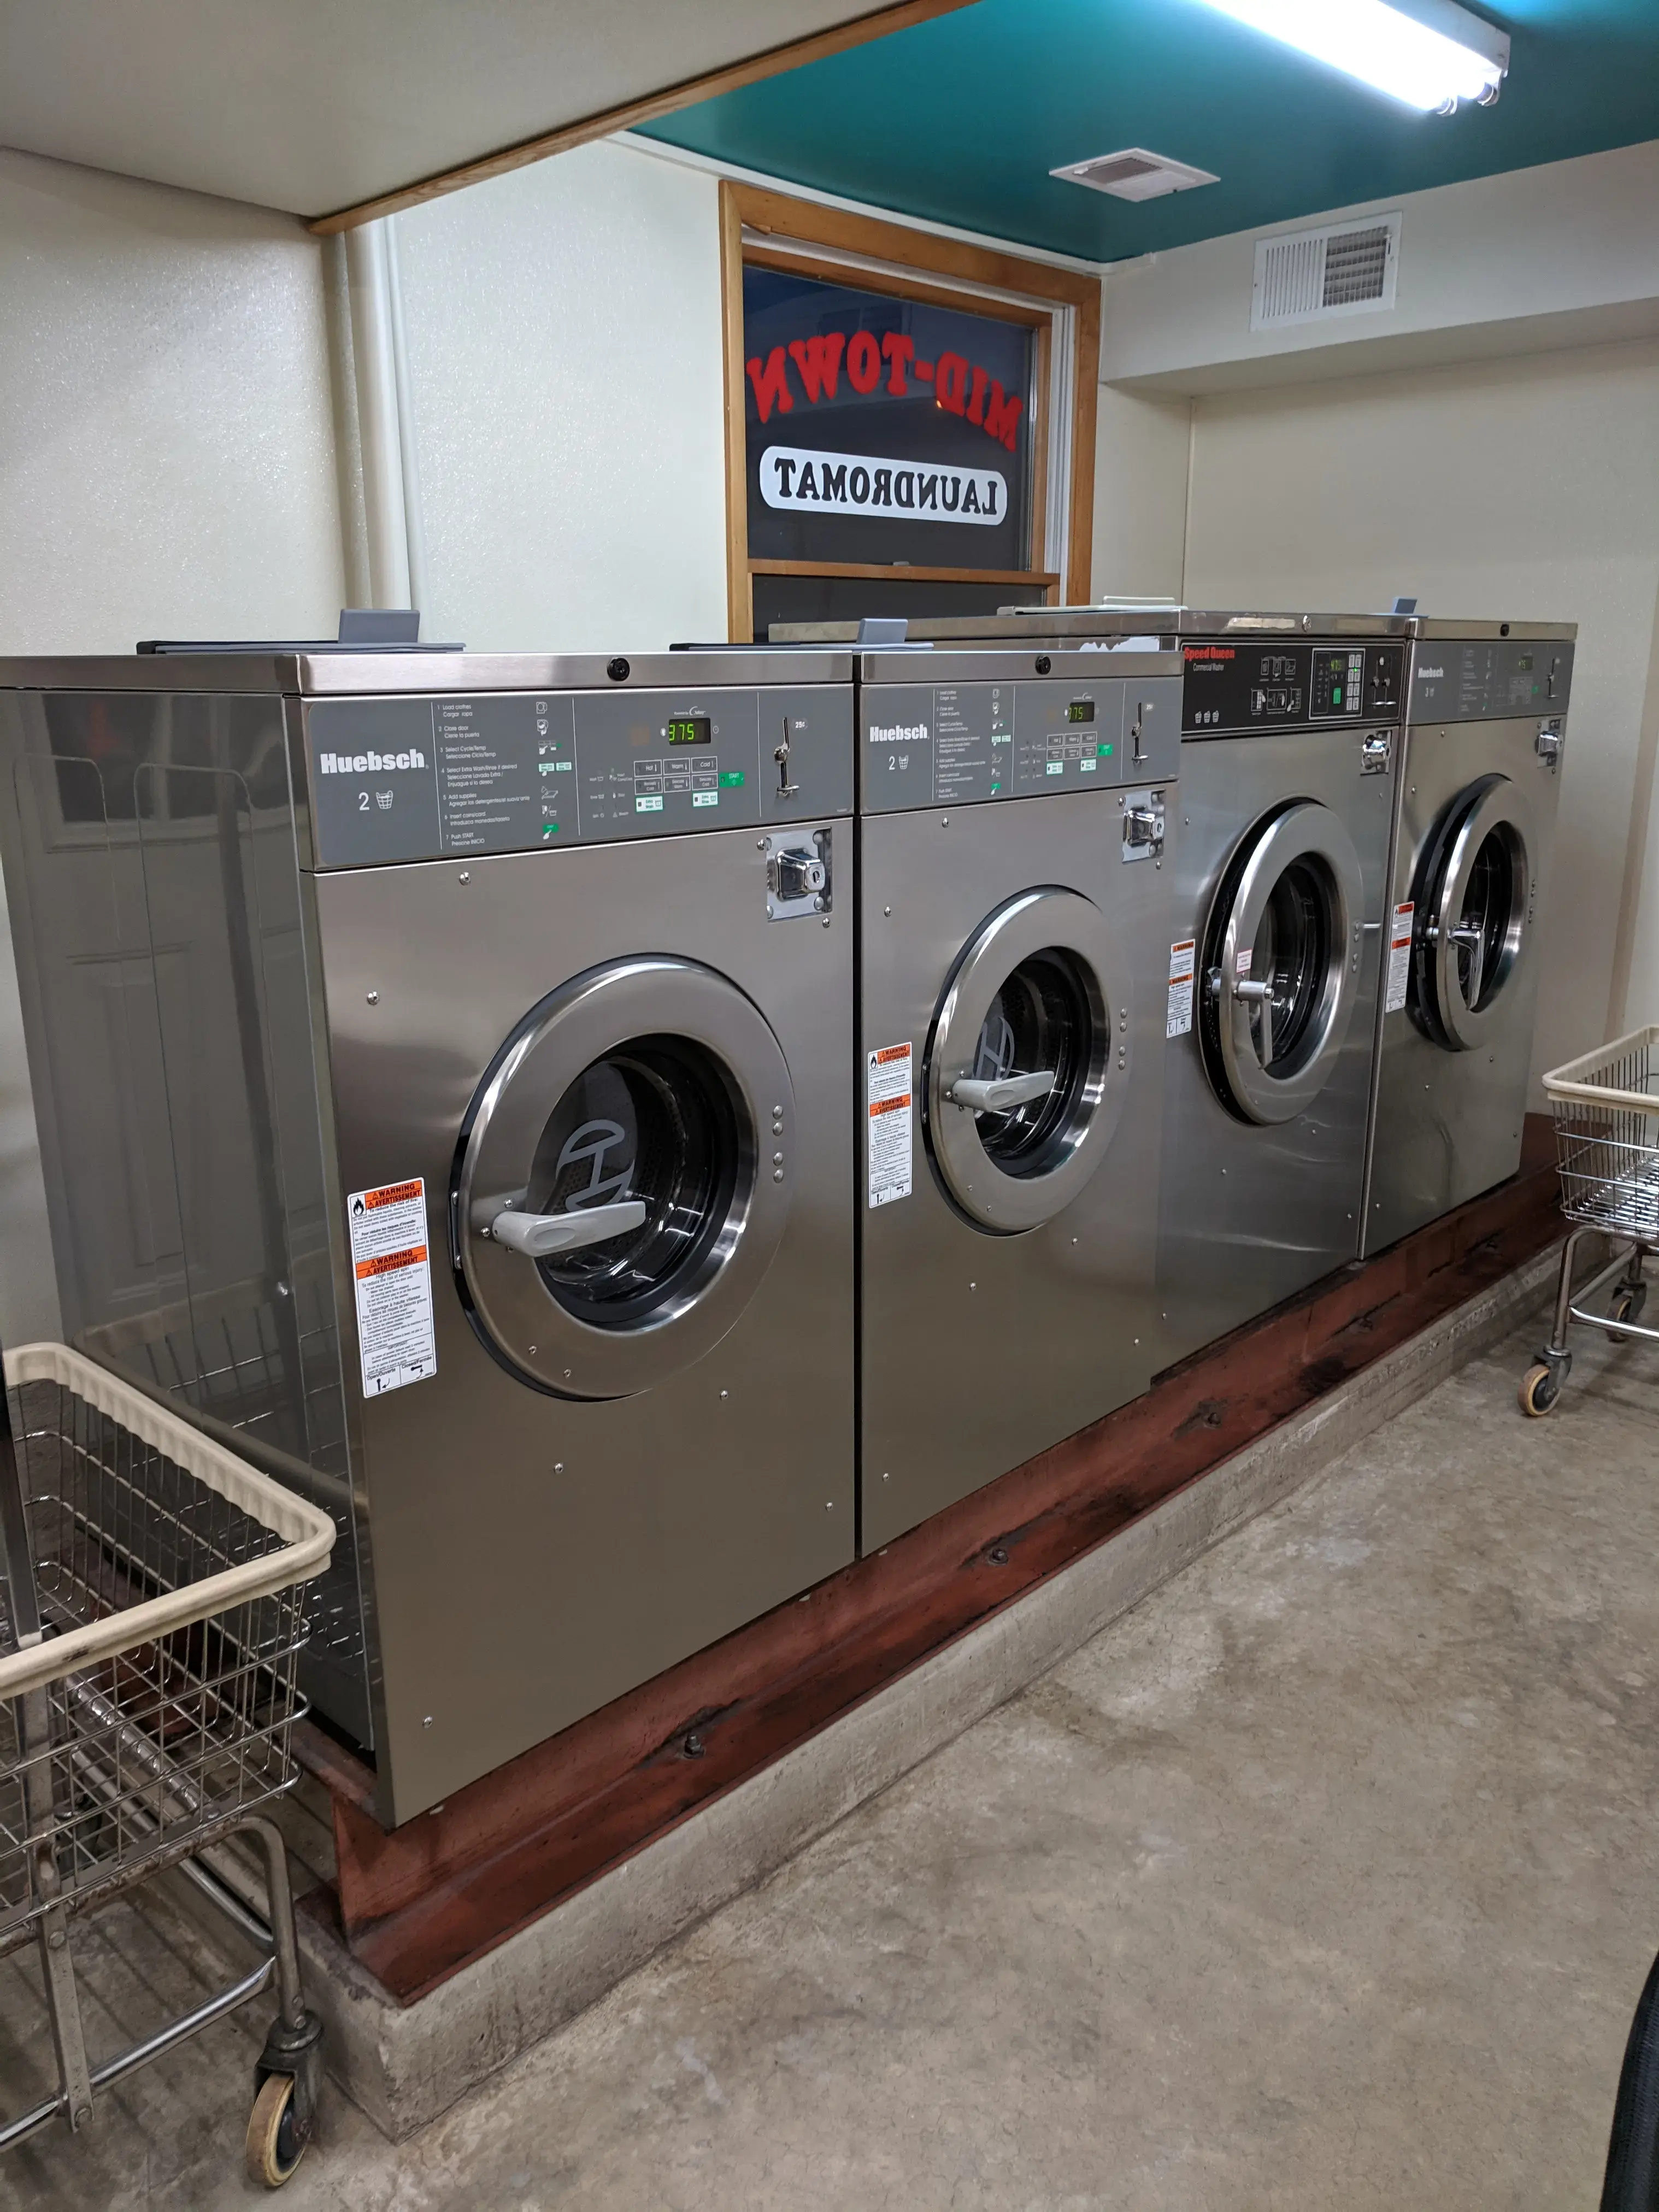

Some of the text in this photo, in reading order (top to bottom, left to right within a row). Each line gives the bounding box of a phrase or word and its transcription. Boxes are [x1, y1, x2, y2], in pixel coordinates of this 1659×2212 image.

[1184, 646, 1235, 662] Speed Queen
[1418, 666, 1444, 679] Huebsch
[669, 723, 694, 741] 375
[870, 723, 928, 742] Huebsch
[320, 749, 425, 774] Huebsch
[889, 756, 895, 770] 2
[358, 792, 369, 811] 2
[885, 1045, 907, 1055] WARNING
[881, 1097, 903, 1107] WARNING
[379, 1183, 415, 1197] WARNING
[375, 1190, 421, 1207] AVERTISSEMENT
[373, 1256, 418, 1274] AVERTISSEMENT
[376, 1250, 413, 1264] WARNING
